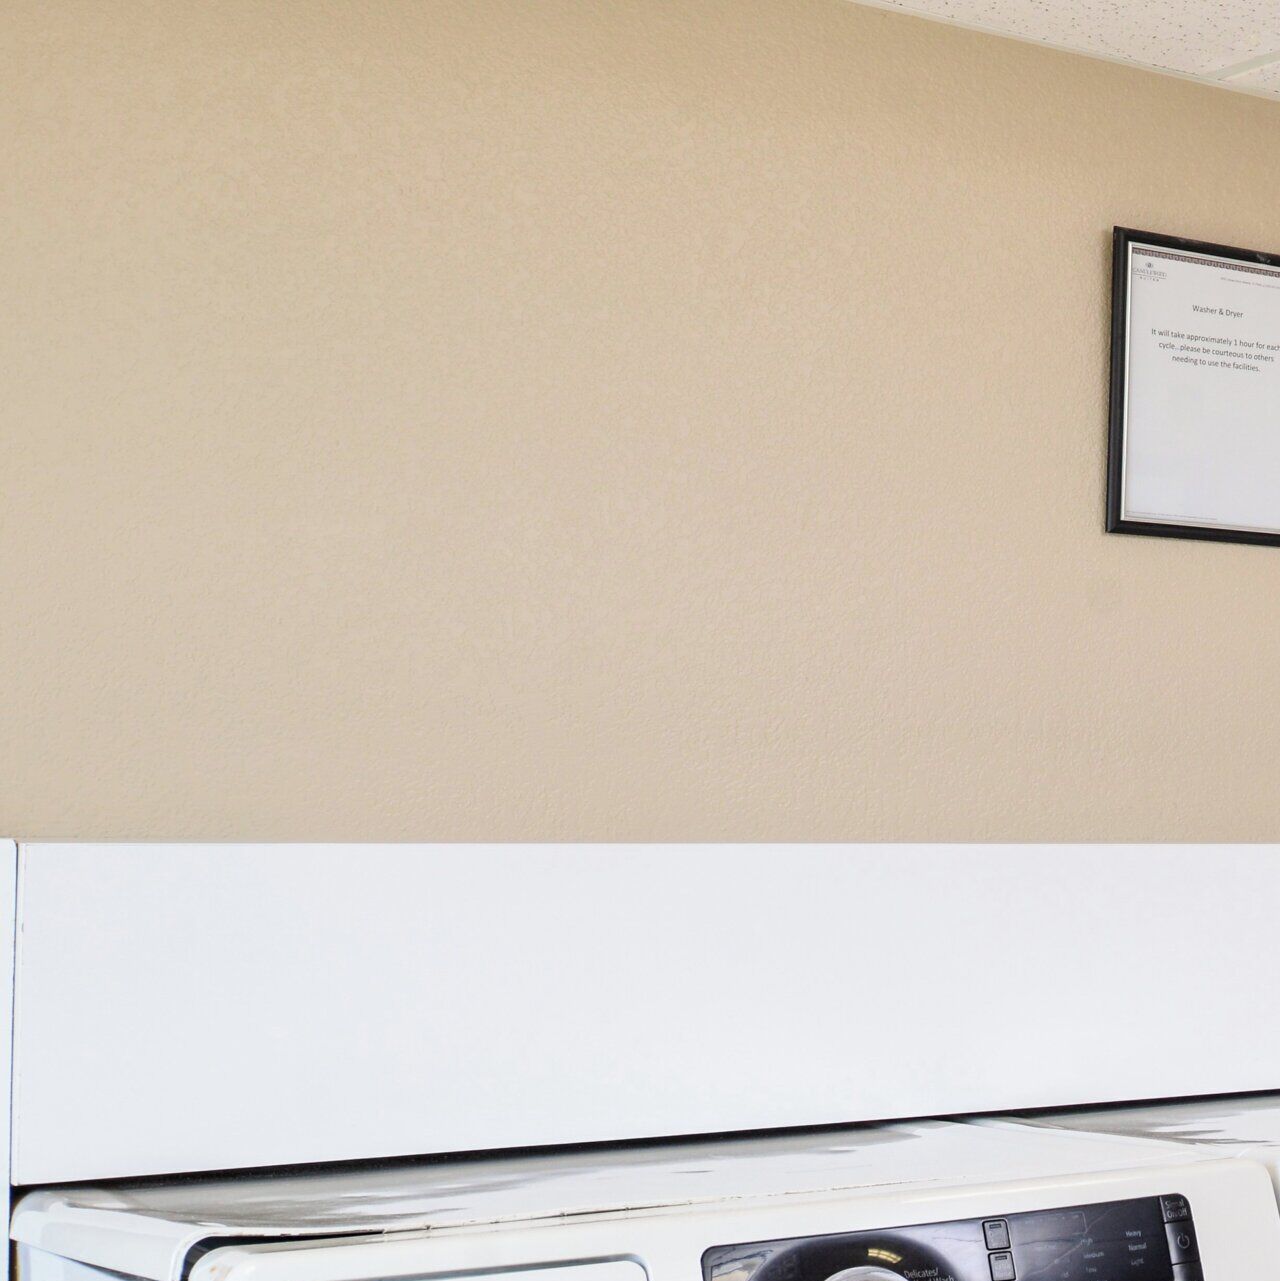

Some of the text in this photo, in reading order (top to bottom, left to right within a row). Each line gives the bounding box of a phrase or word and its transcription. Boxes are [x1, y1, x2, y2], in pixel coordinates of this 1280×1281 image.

[1192, 304, 1244, 319] Washer & Dryer
[1158, 329, 1170, 337] will
[1171, 331, 1185, 339] take
[1186, 334, 1232, 347] approximately
[1239, 339, 1254, 348] hour
[1256, 341, 1265, 350] for
[1202, 347, 1210, 355] be
[1211, 349, 1244, 359] courteous
[1245, 352, 1252, 360] to
[1253, 354, 1275, 362] others
[1171, 355, 1261, 373] needing to use the facilities.
